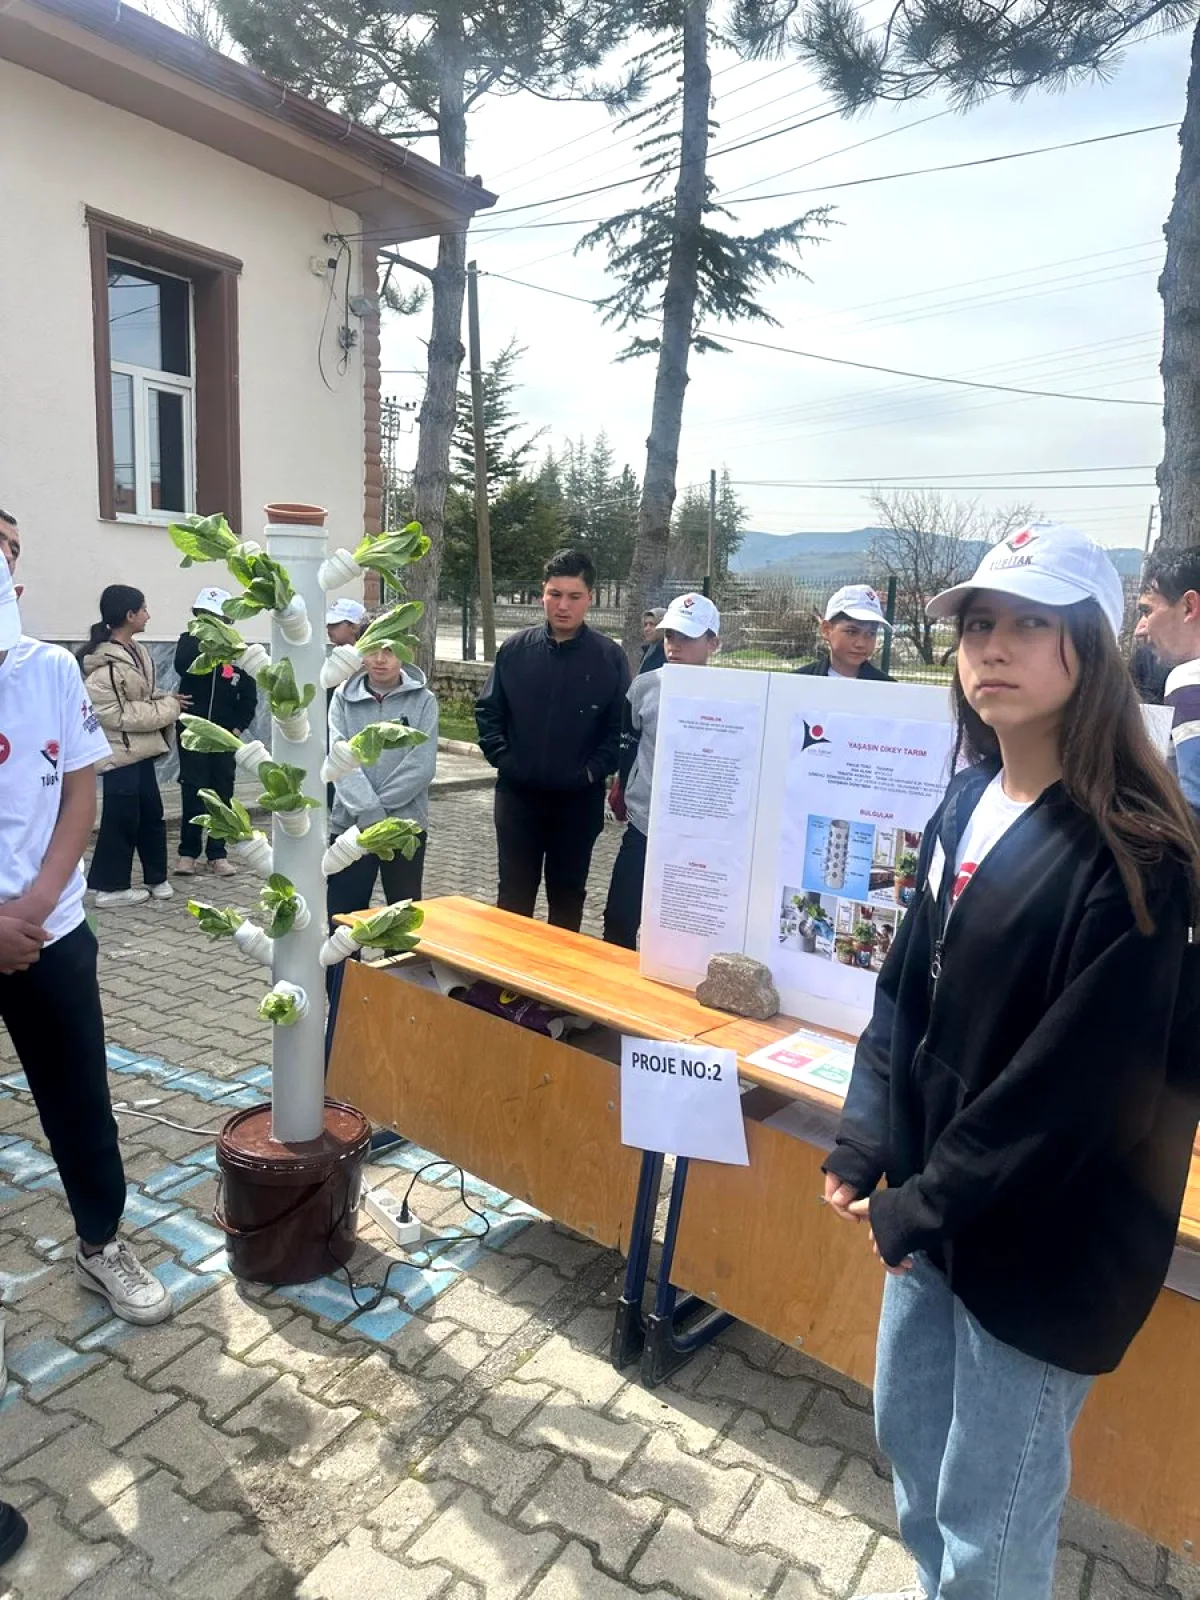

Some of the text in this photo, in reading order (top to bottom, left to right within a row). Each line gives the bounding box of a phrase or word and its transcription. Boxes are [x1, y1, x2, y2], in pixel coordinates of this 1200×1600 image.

[859, 809, 894, 819] BULGULAR
[632, 1051, 722, 1081] PROJE NO:2
